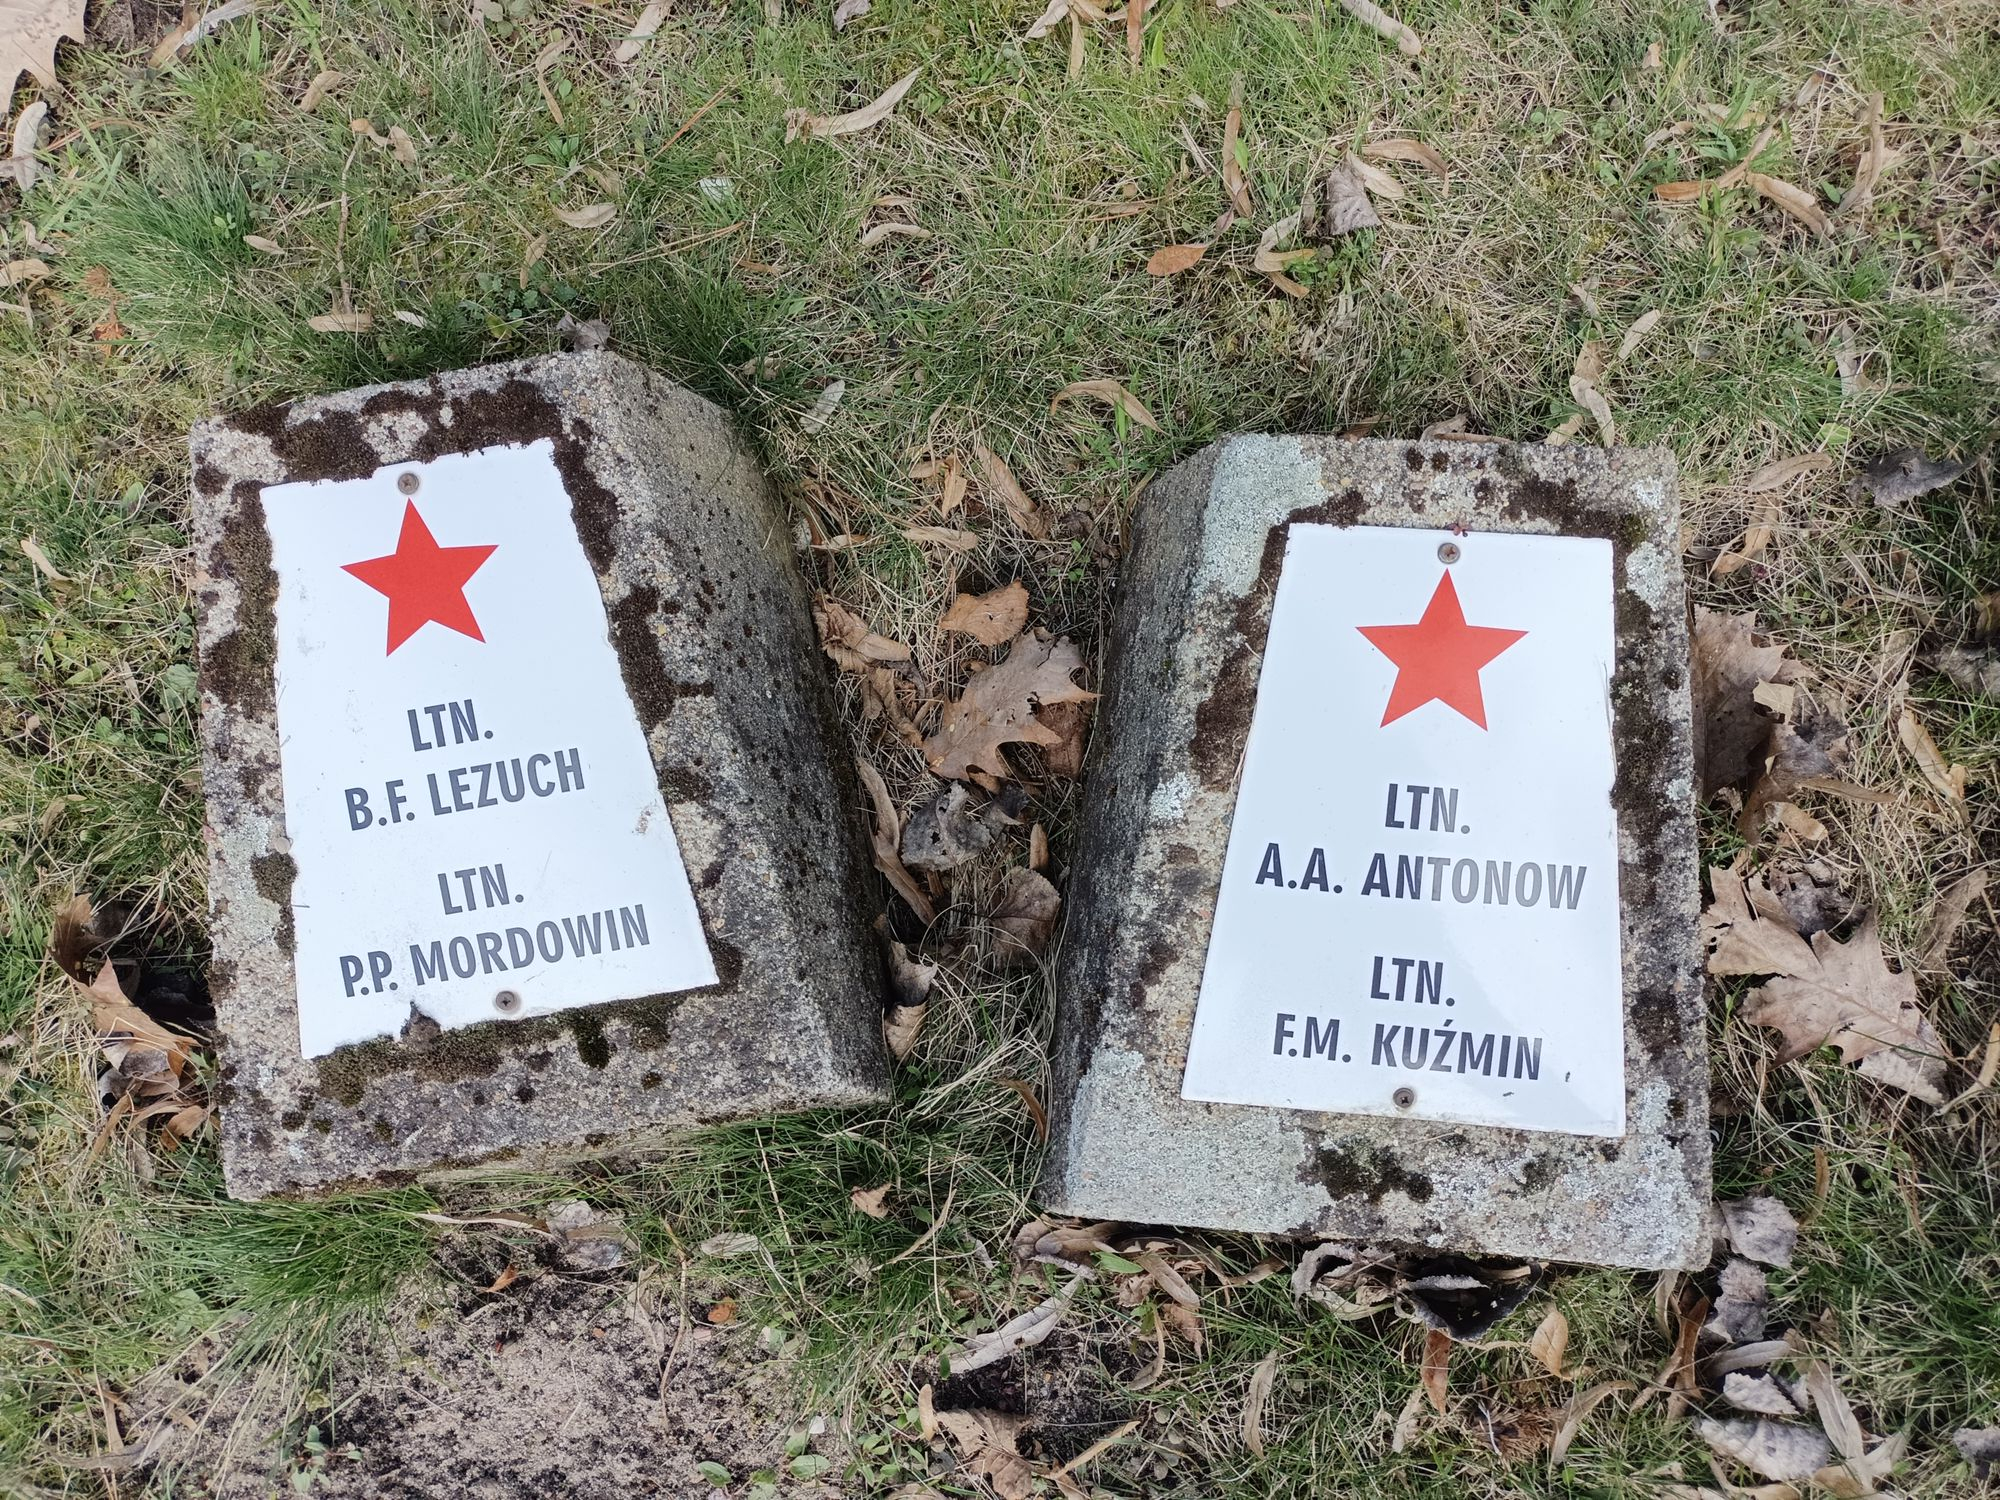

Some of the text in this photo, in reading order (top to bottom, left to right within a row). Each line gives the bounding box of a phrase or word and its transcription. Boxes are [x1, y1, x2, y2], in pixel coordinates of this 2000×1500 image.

[407, 698, 494, 752] LTN.
[344, 747, 585, 831] B.F. LEZUCH
[1384, 783, 1471, 834] LTN.
[437, 863, 524, 916] LTN.
[1252, 842, 1587, 910] A.A. ANTONOW
[339, 903, 650, 998] P.P. MORDOWIN
[1370, 955, 1456, 1007] LTN.
[1273, 1012, 1542, 1081] F.M. KUŹMIN
